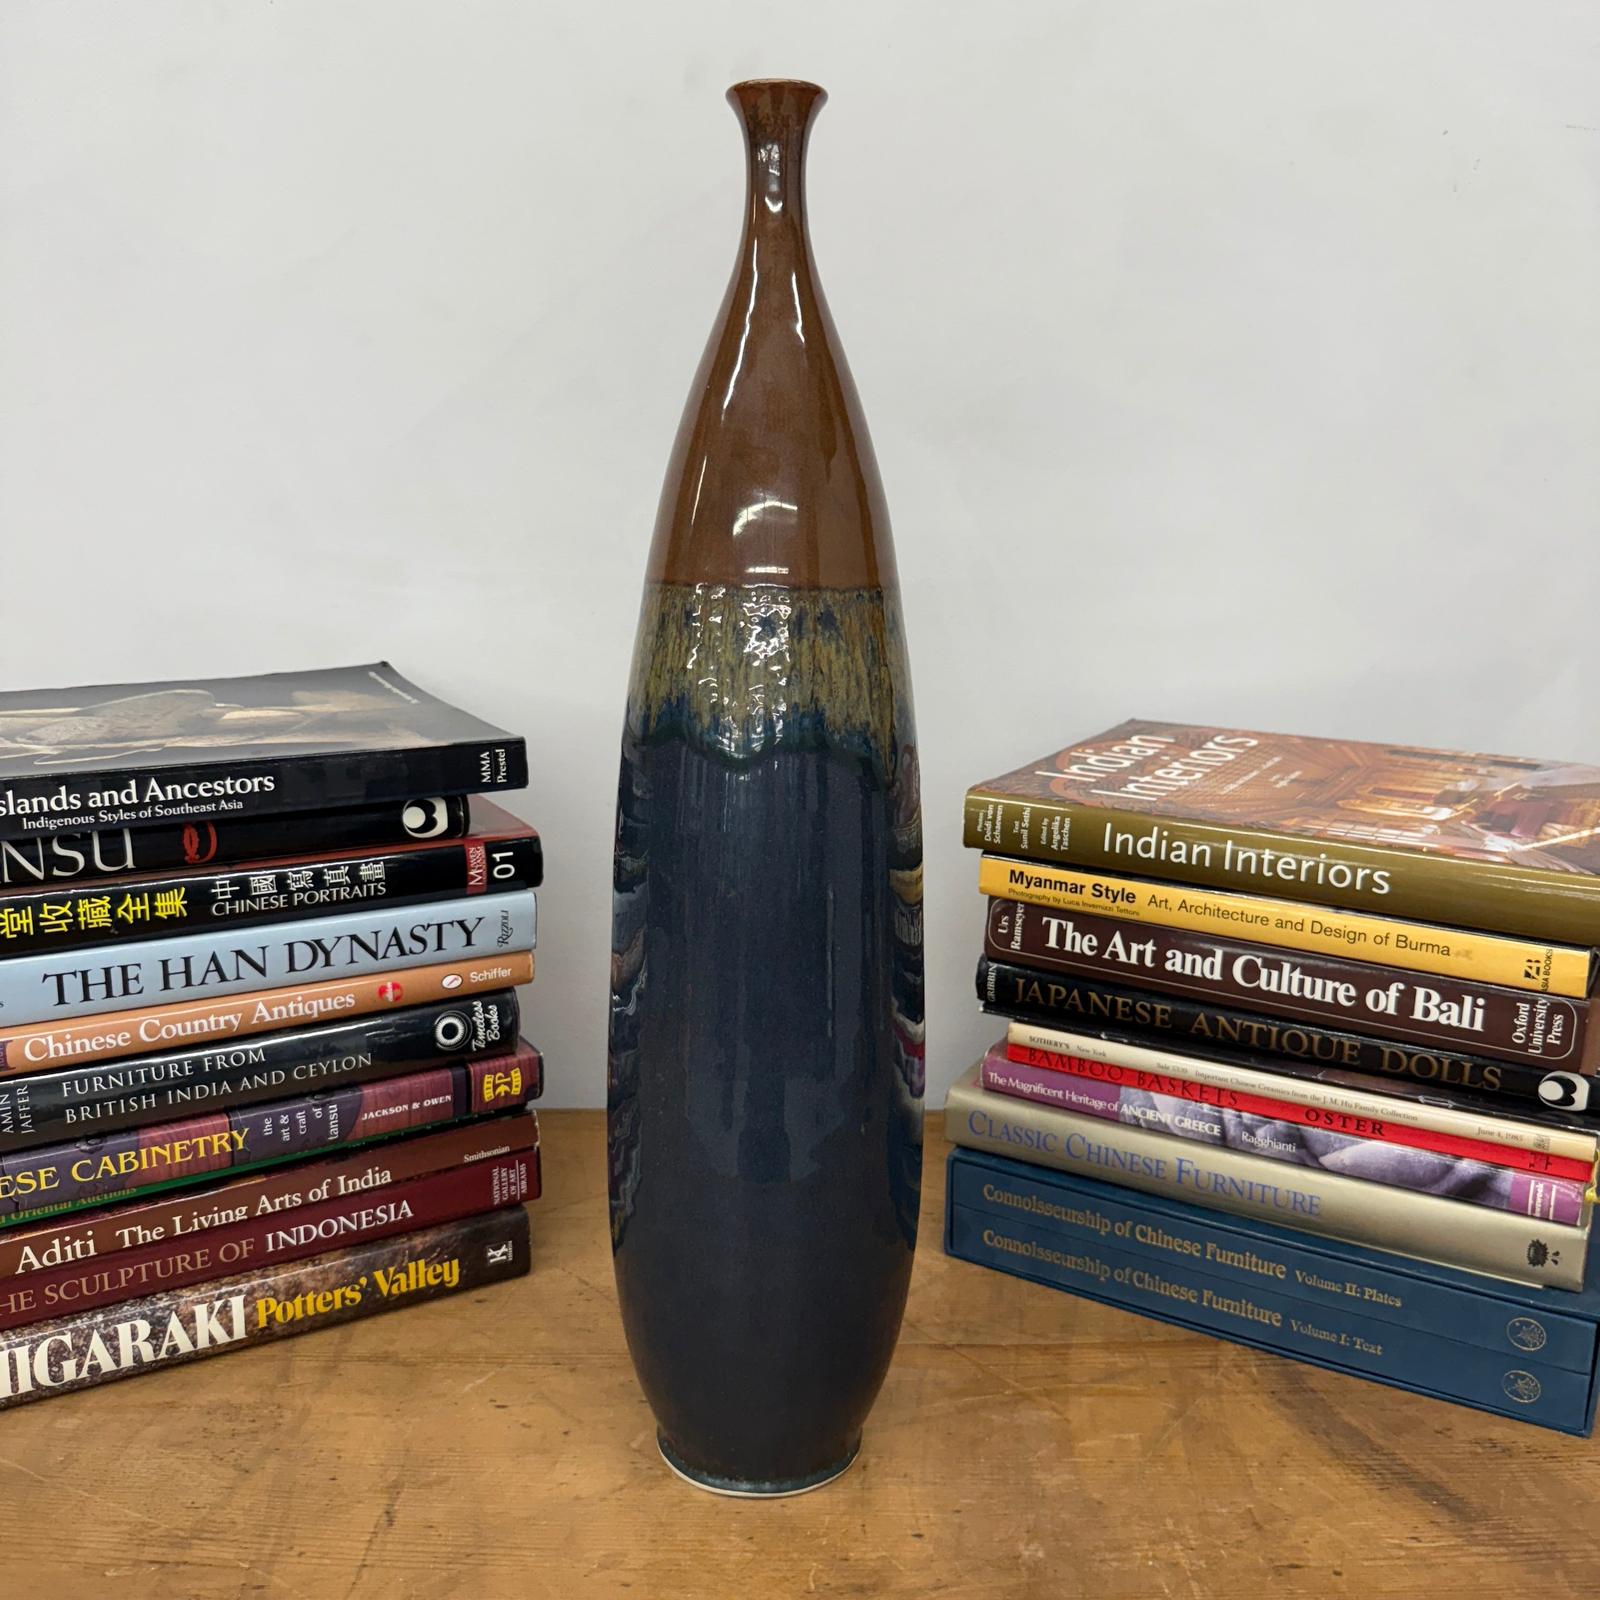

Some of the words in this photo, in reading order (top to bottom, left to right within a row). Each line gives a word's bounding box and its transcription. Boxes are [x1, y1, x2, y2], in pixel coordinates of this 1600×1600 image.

[479, 751, 492, 783] MMA
[495, 748, 508, 783] Prestel
[1035, 734, 1175, 782] Indian
[1091, 735, 1258, 800] Interiors
[88, 780, 138, 807] and
[144, 775, 275, 803] Ancestors
[23, 813, 95, 830] Indigenous
[99, 806, 137, 823] Styles
[139, 802, 151, 818] of
[155, 801, 216, 817] Southeast
[219, 799, 243, 811] Asia
[986, 804, 994, 819] von
[1022, 807, 1031, 828] Sethi
[984, 820, 992, 840] Deidi
[1021, 829, 1029, 849] Sunil
[1051, 816, 1060, 851] Angelika
[1061, 818, 1070, 851] Taschen
[493, 851, 515, 879] 01
[1103, 822, 1211, 867] Indian
[1224, 840, 1391, 895] Interiors
[211, 894, 288, 916] CHINESE
[293, 882, 386, 906] PORTRAITS
[1008, 887, 1050, 902] Photography
[1052, 895, 1061, 904] by
[1063, 898, 1080, 906] Luca
[1009, 869, 1086, 895] Myanmar
[1092, 883, 1136, 904] Style
[1147, 894, 1172, 912] Art,
[1177, 899, 1269, 926] Architecture
[1275, 916, 1304, 932] and
[1310, 920, 1367, 944] Design
[1373, 932, 1390, 946] of
[1395, 933, 1451, 957] Burma
[998, 915, 1009, 934] Urs
[1010, 902, 1025, 950] Ramseyer
[42, 963, 144, 1006] THE
[158, 945, 269, 991] HAN
[284, 917, 485, 974] DYNASTY
[470, 967, 512, 983] Schiffer
[1042, 916, 1098, 956] The
[1101, 930, 1157, 968] Art
[1164, 948, 1223, 981] and
[1232, 954, 1356, 1007] Culture
[1365, 982, 1406, 1015] of
[1409, 986, 1486, 1032] Bali
[1543, 948, 1553, 974] BOOKS
[987, 963, 997, 1002] GRIBBIN
[24, 1031, 131, 1062] Chinese
[139, 1010, 242, 1043] Country
[251, 993, 355, 1025] Antiques
[484, 1004, 500, 1042] Books
[1015, 978, 1172, 1029] JAPANESE
[1190, 1011, 1361, 1065] ANTIQUE
[1380, 1047, 1502, 1090] DOLLS
[1512, 1002, 1530, 1044] Oxford
[1528, 997, 1551, 1054] University
[1547, 1014, 1564, 1045] Press
[1029, 1035, 1070, 1050] SOTHEBY'S
[1077, 1045, 1091, 1053] New
[1093, 1047, 1107, 1057] York
[62, 1059, 194, 1098] FURNITURE
[204, 1048, 266, 1072] FROM
[65, 1093, 157, 1124] BRITISH
[168, 1080, 232, 1105] INDIA
[239, 1070, 286, 1091] AND
[293, 1053, 372, 1080] CEYLON
[1028, 1048, 1123, 1082] BAMBOO
[1137, 1071, 1238, 1106] BASKETS
[0, 1093, 14, 1133] AMIN
[17, 1084, 36, 1134] JAFFER
[312, 1107, 322, 1119] of
[362, 1103, 409, 1121] JACKSON
[412, 1100, 421, 1109] &
[424, 1095, 452, 1107] OWEN
[988, 1072, 1007, 1085] The
[1008, 1077, 1063, 1099] Magnificent
[1066, 1090, 1106, 1110] Heritage
[1107, 1101, 1119, 1112] of
[1120, 1105, 1172, 1124] ANCIENT
[1174, 1115, 1222, 1136] GREECE
[1196, 1071, 1228, 1083] Important
[1230, 1076, 1256, 1088] Chinese
[1292, 1089, 1308, 1099] from
[1310, 1093, 1321, 1101] the
[1354, 1103, 1378, 1114] Family
[1380, 1108, 1418, 1121] Collection
[263, 1117, 272, 1136] the
[280, 1114, 290, 1125] &
[280, 1127, 290, 1142] art
[296, 1110, 307, 1135] craft
[1304, 1108, 1384, 1136] OSTER
[464, 1145, 510, 1163] Smithsonian
[1241, 1131, 1297, 1153] Ragghianti
[0, 1166, 60, 1199] ESE
[71, 1127, 250, 1182] CABINETRY
[520, 1163, 528, 1194] ABRAMS
[968, 1110, 1059, 1152] CLASSIC
[1066, 1133, 1167, 1180] CHINESE
[1176, 1157, 1321, 1216] FURNITURE
[492, 1165, 501, 1205] NATIONAL
[15, 1231, 98, 1274] Aditi
[115, 1224, 165, 1249] The
[172, 1206, 248, 1236] Living
[255, 1194, 302, 1216] Arts
[308, 1178, 331, 1201] of
[338, 1166, 392, 1195] India
[44, 1248, 212, 1304] SCULPTURE
[219, 1238, 255, 1263] OF
[265, 1200, 413, 1252] INDONESIA
[983, 1184, 1111, 1235] Connoisseurship
[1114, 1221, 1134, 1238] of
[1135, 1224, 1201, 1257] Chinese
[1205, 1241, 1287, 1280] Furniture
[1295, 1269, 1341, 1293] Volume
[1344, 1282, 1361, 1297] II:
[1363, 1287, 1402, 1308] Plates
[373, 1258, 459, 1297] Valley
[983, 1230, 1111, 1282] Connoisseurship
[1113, 1267, 1134, 1284] of
[1133, 1271, 1199, 1304] Chinese
[1202, 1288, 1282, 1327] Furniture
[1290, 1319, 1336, 1342] Volume
[1339, 1334, 1350, 1347] I:
[1353, 1336, 1383, 1356] Text
